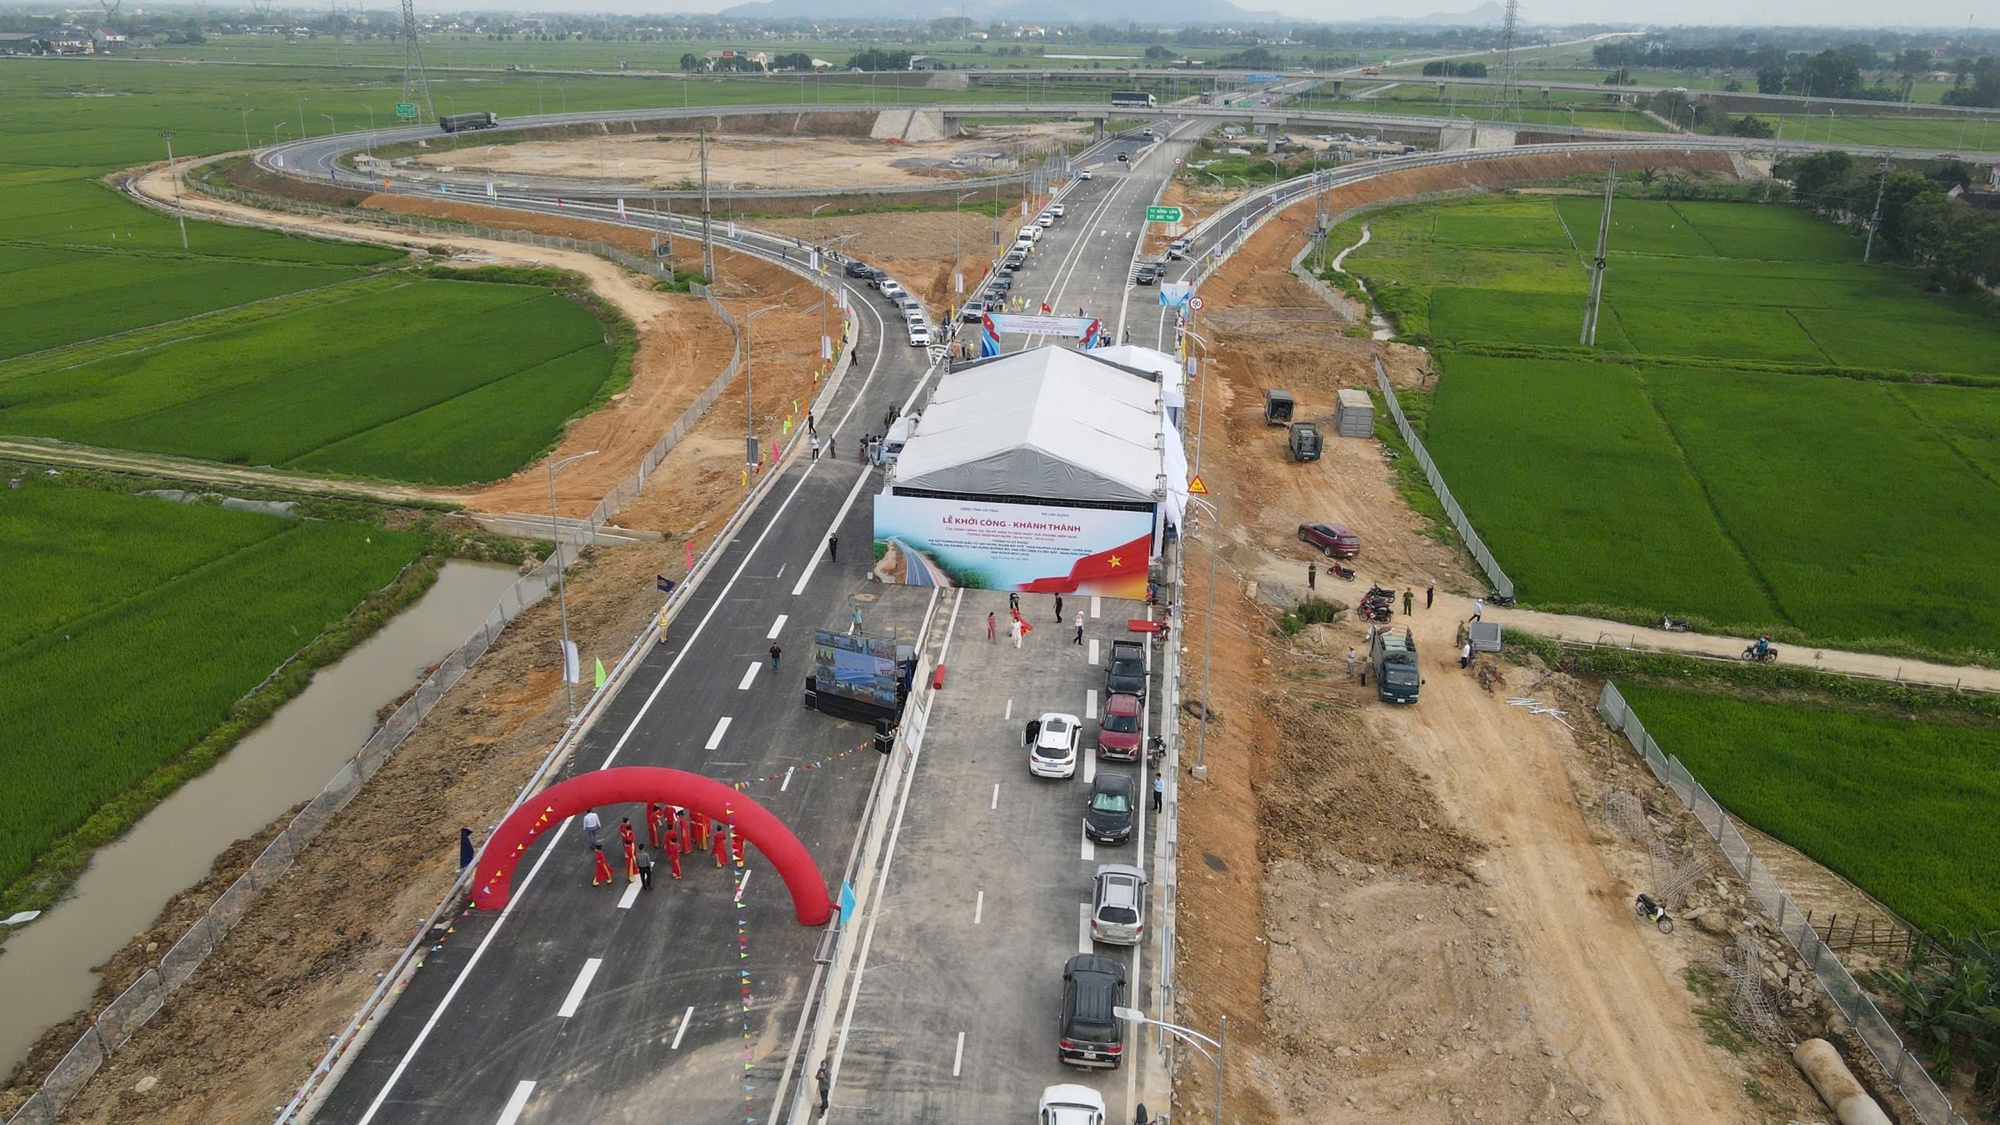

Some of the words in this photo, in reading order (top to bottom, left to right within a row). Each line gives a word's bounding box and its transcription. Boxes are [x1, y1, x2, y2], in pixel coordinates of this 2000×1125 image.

[942, 515, 953, 524] LỄ
[955, 516, 978, 525] KHỞI
[980, 518, 1006, 527] CÔNG
[1013, 521, 1046, 530] KHÁNH
[1048, 523, 1081, 532] THÀNH
